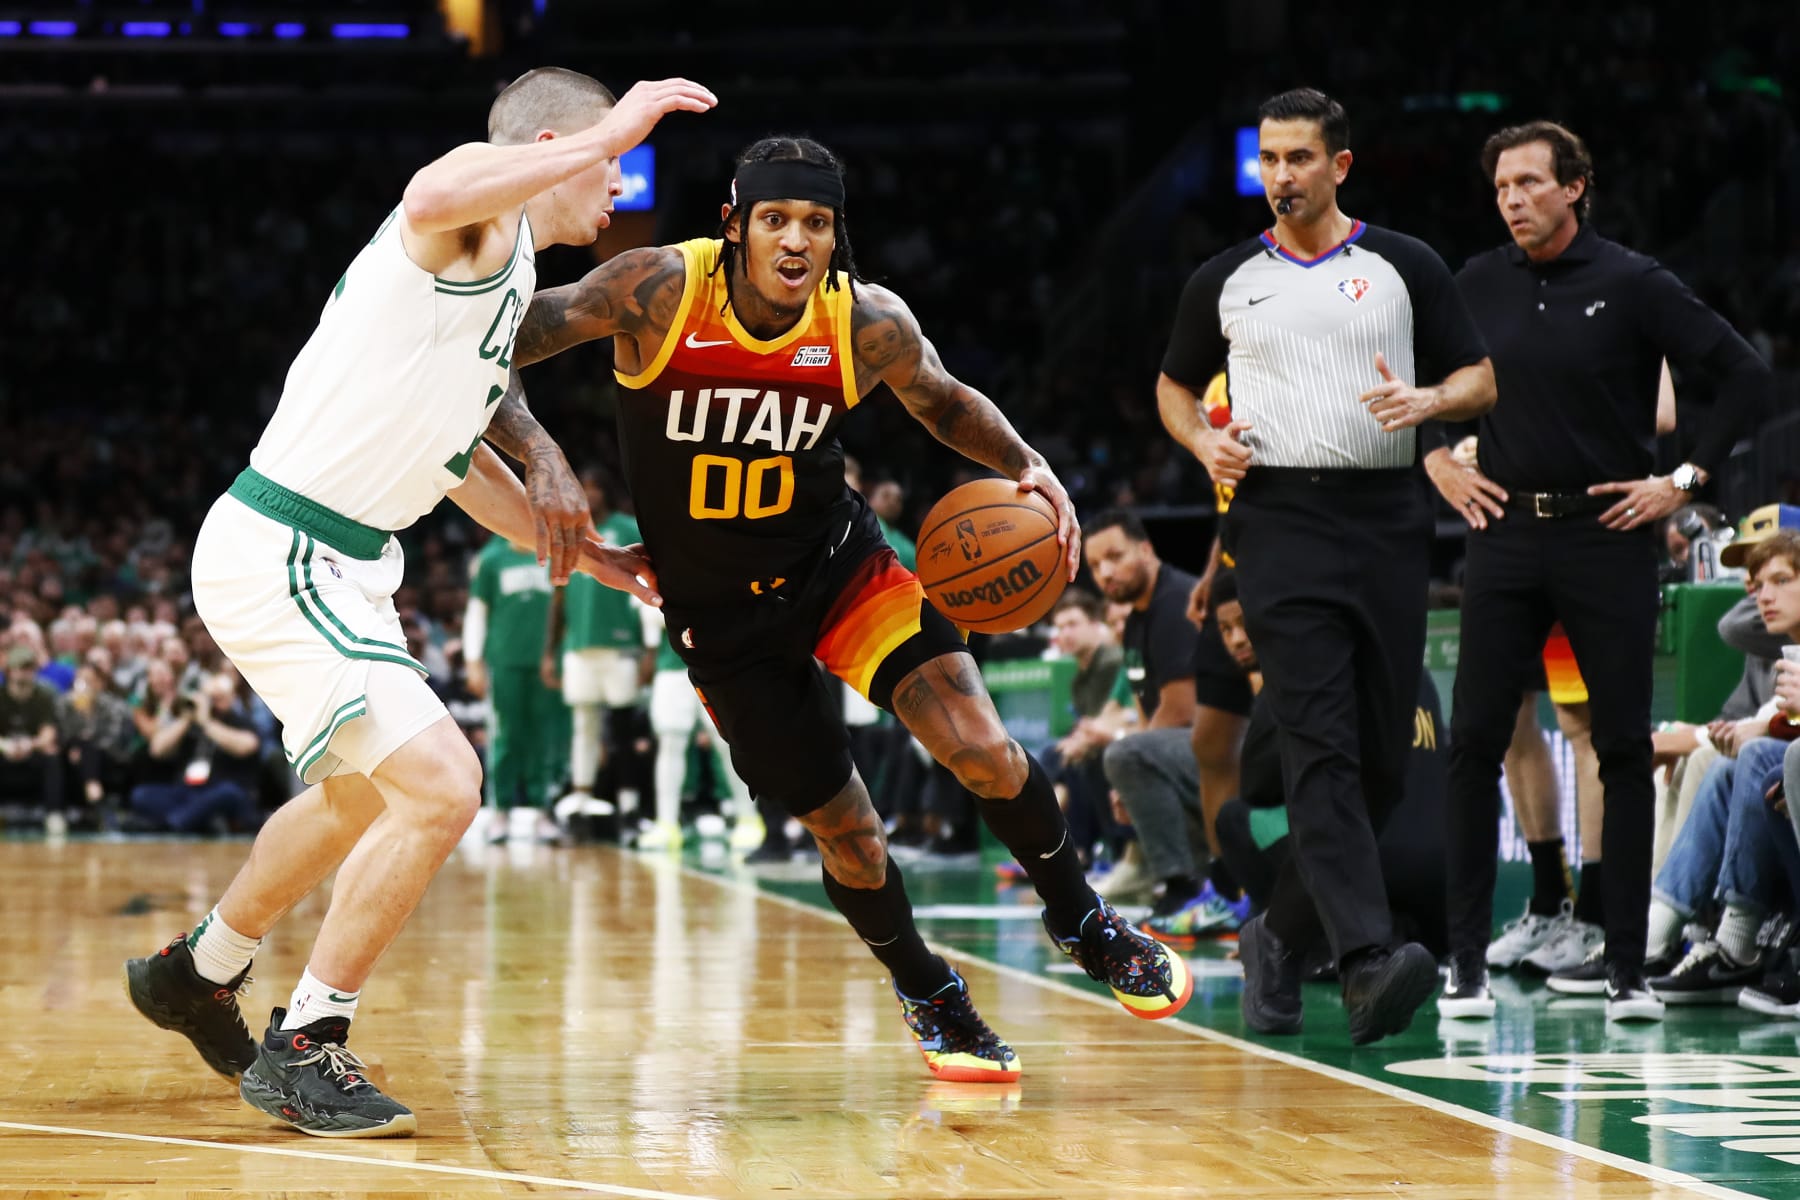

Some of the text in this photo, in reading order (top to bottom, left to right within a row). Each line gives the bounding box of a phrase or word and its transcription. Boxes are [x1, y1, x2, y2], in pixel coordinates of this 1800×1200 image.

[793, 347, 806, 365] 5
[804, 356, 830, 365] FIGHT
[665, 388, 833, 452] UTAH
[689, 453, 796, 520] 00
[939, 558, 1043, 608] Wilson
